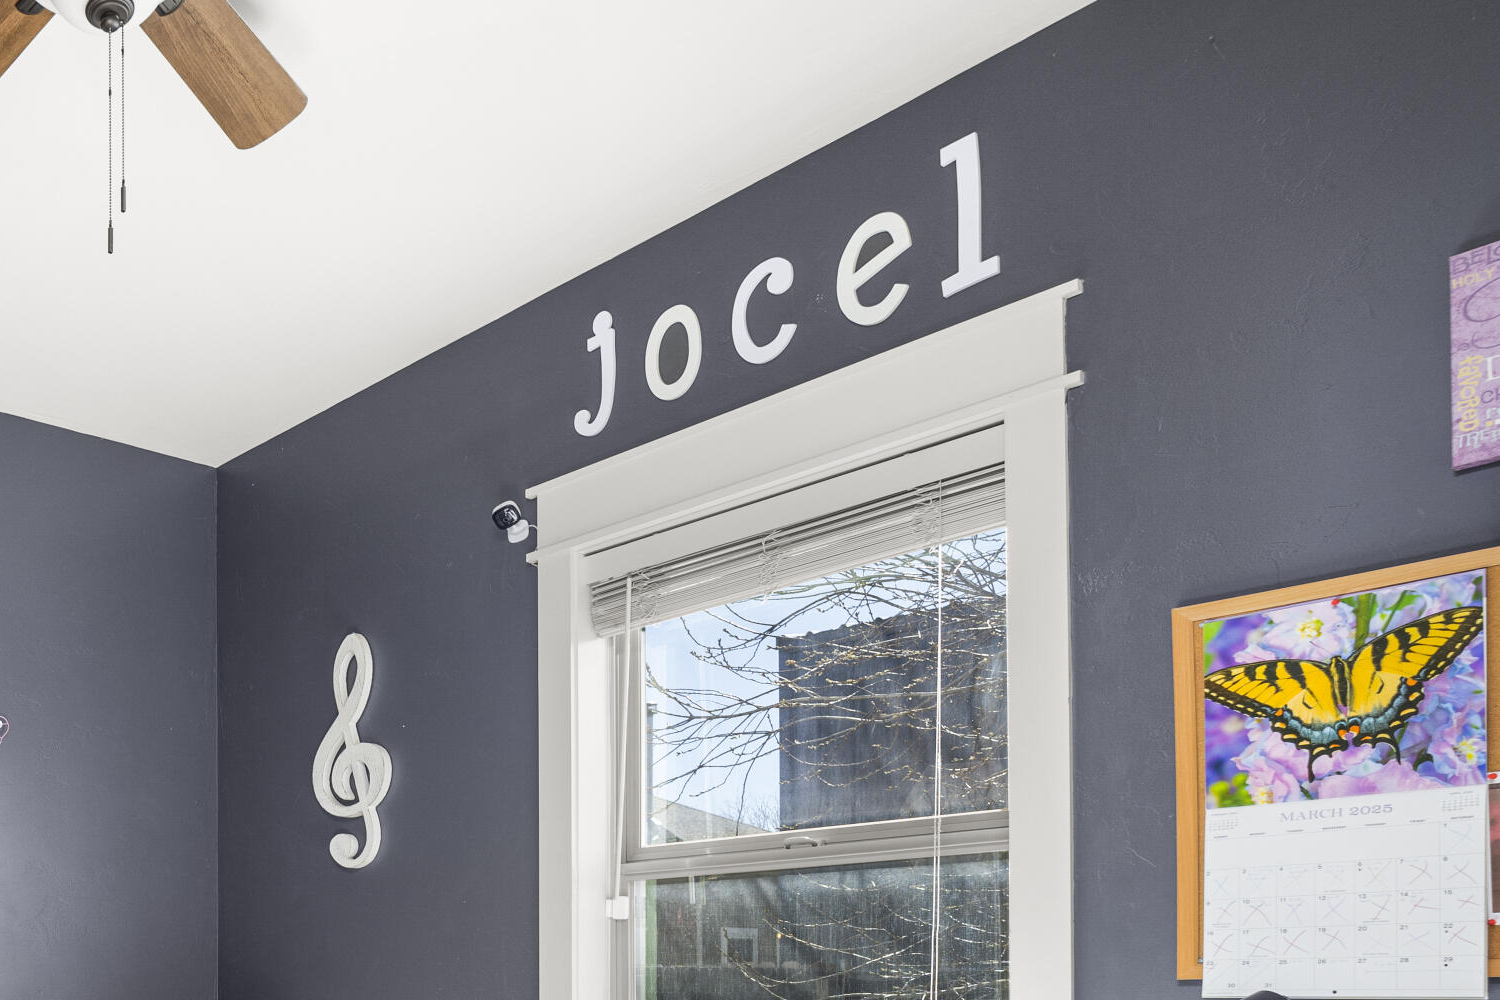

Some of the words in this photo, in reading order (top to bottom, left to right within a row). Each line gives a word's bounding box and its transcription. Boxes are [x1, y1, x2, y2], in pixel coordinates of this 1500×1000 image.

[574, 132, 1000, 437] jocel
[1452, 266, 1496, 289] HOLY
[1280, 808, 1343, 822] MARCH
[1349, 804, 1393, 816] 2025
